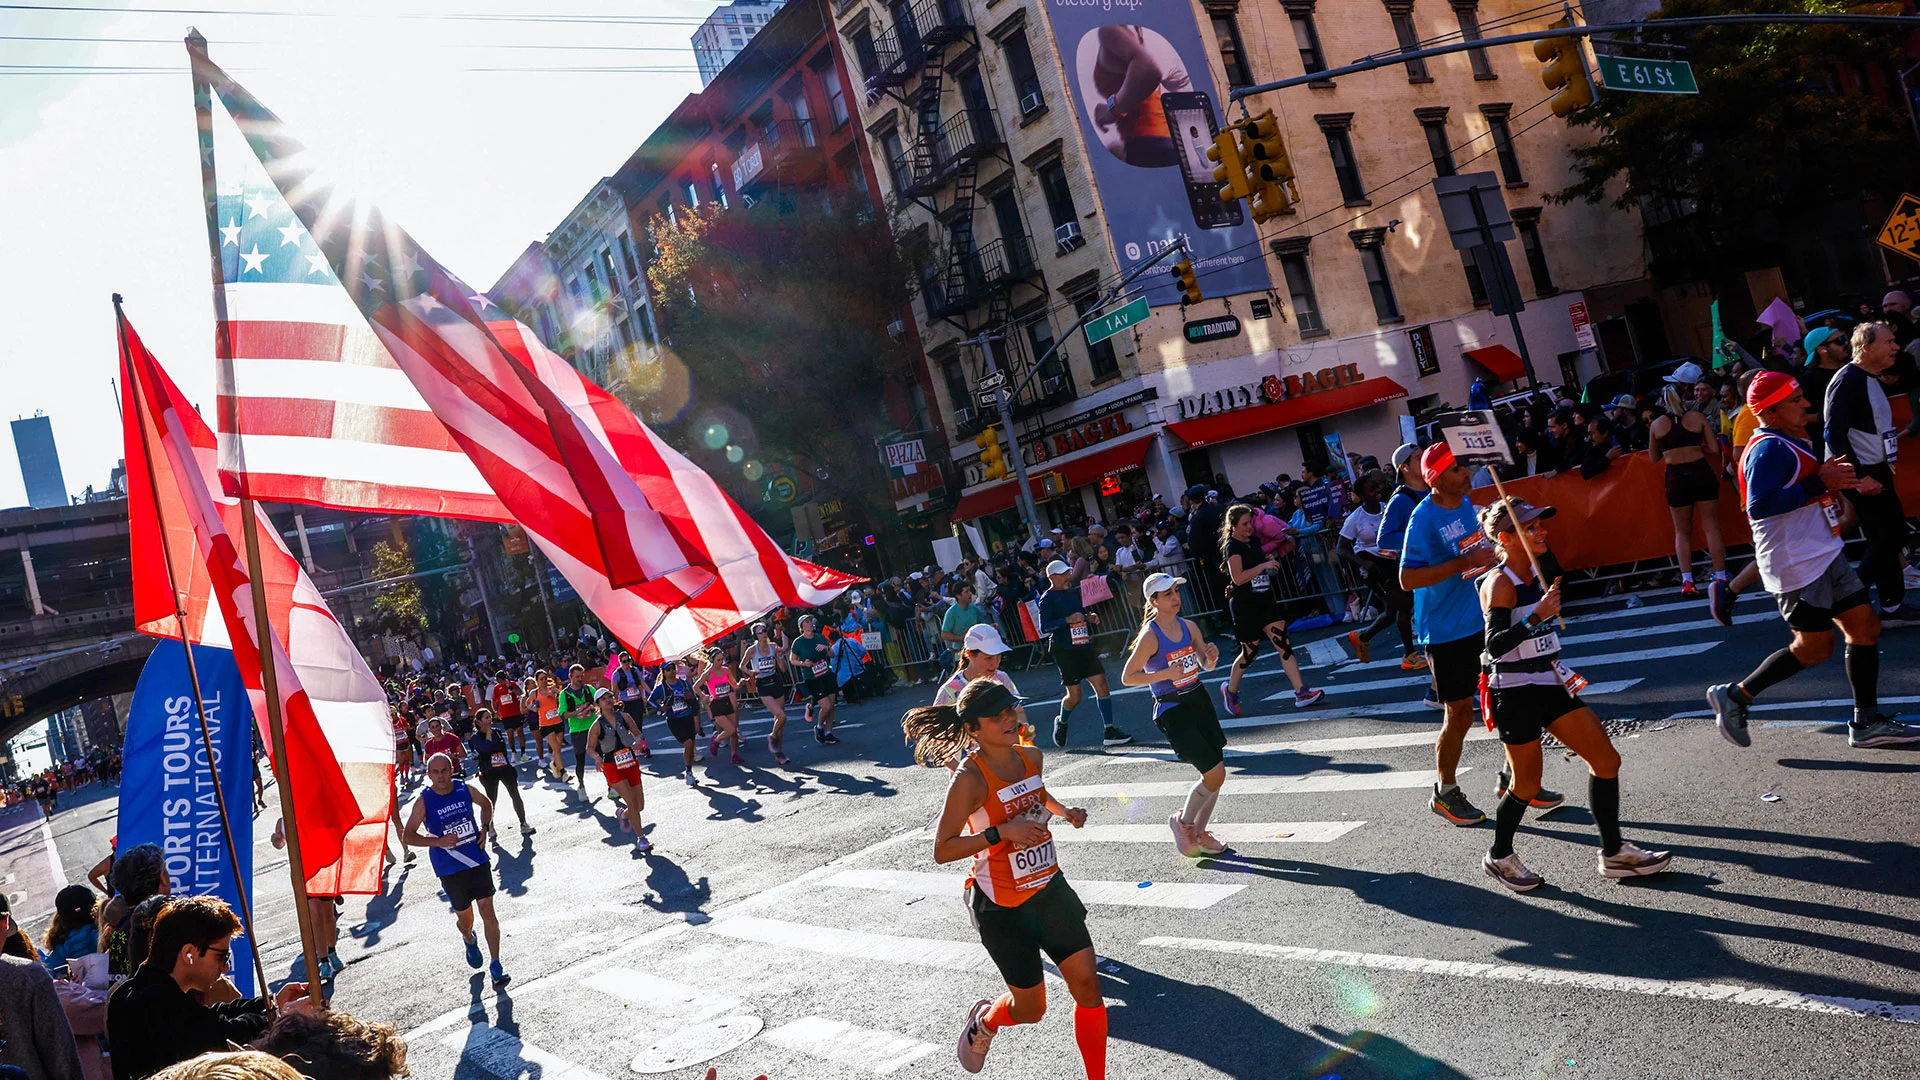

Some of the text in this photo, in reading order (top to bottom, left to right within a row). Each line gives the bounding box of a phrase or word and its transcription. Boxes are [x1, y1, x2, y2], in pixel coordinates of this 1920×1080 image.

[1618, 64, 1675, 86] E 61 St
[1227, 255, 1245, 266] here
[1106, 312, 1128, 331] 1 Av
[1412, 333, 1426, 369] DAILY
[1183, 381, 1261, 419] DAILY
[1283, 362, 1365, 397] BAGEL
[1094, 406, 1108, 416] SOUP
[1053, 411, 1133, 455] BAGEL
[888, 441, 925, 466] PIZZA
[1171, 653, 1197, 669] 830
[162, 695, 192, 902] PORTS TOURS
[195, 690, 222, 900] NTERNATIONAL
[1011, 783, 1028, 796] LUCY
[437, 801, 466, 816] DURSLEY
[1004, 792, 1041, 815] EVERY
[1015, 840, 1054, 870] 60177
